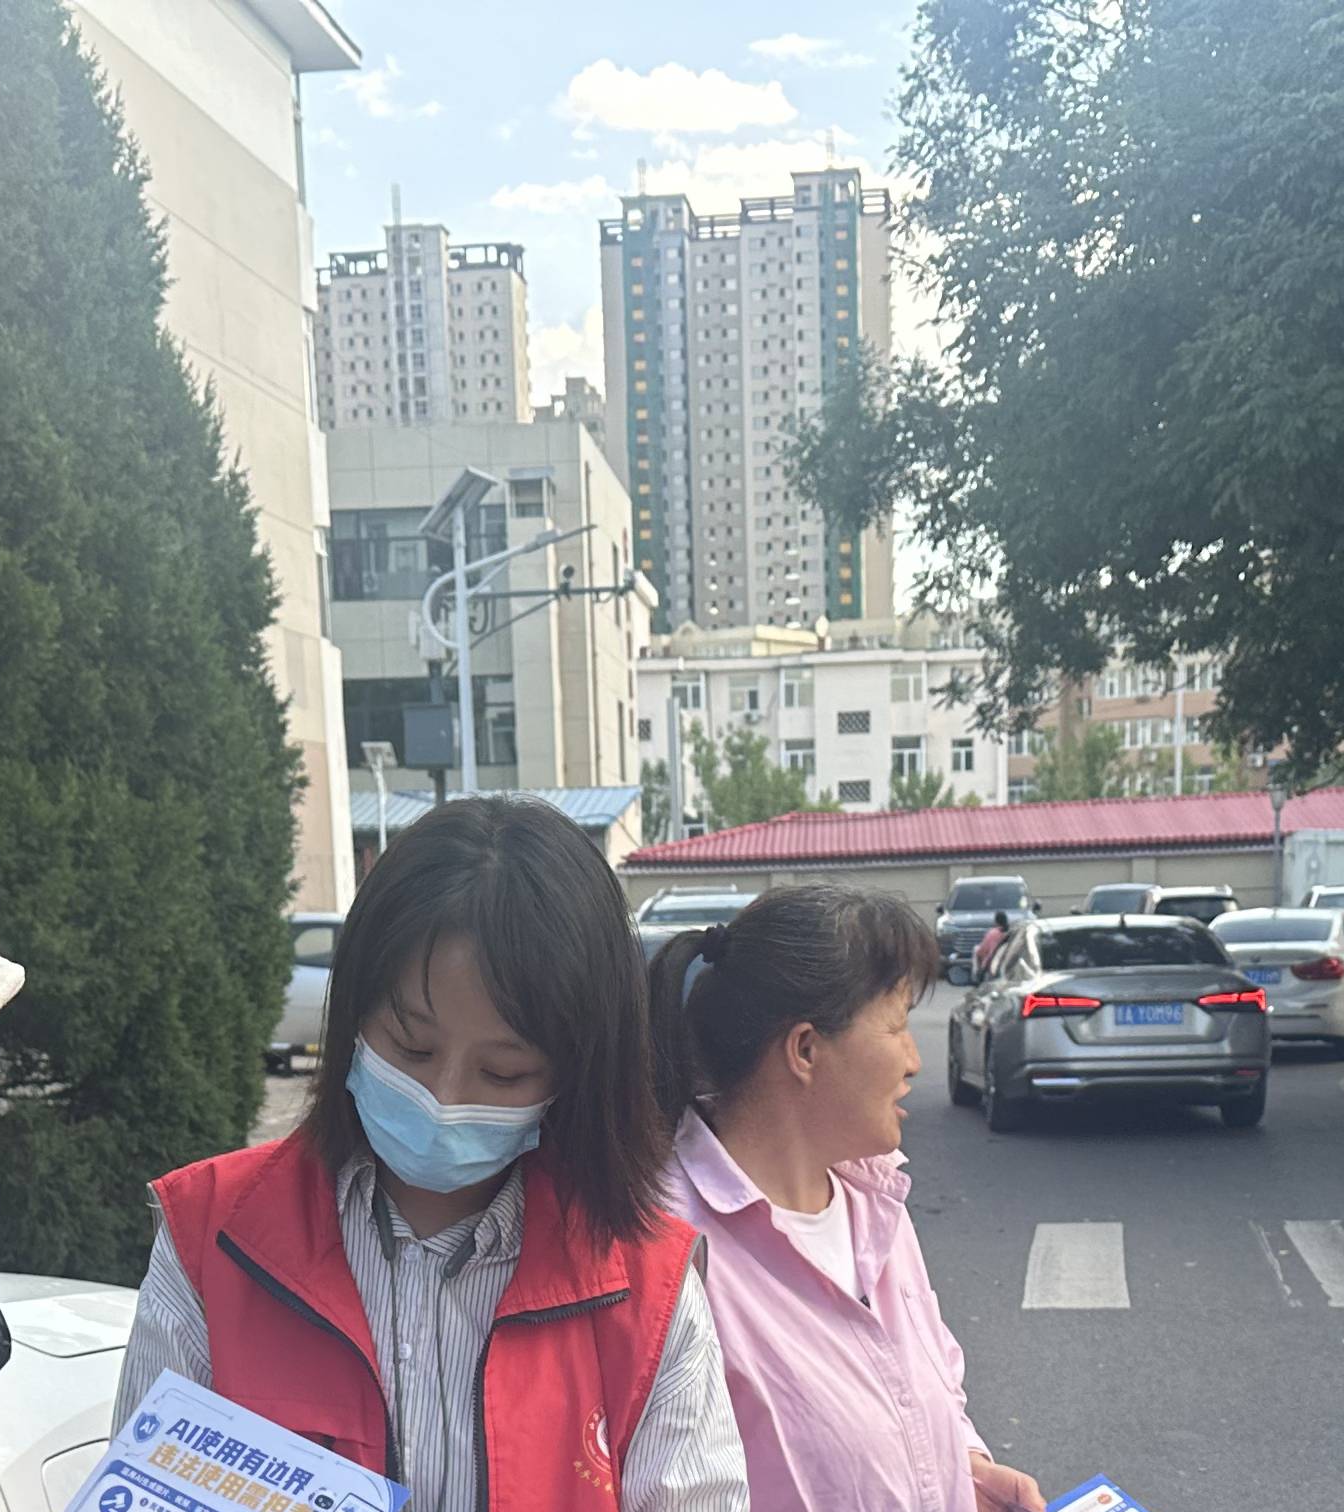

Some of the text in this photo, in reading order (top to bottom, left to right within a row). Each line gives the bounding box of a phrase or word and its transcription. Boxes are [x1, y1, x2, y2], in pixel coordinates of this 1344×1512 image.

[139, 1421, 155, 1434] AI
[166, 1418, 314, 1496] AI使用有边界
